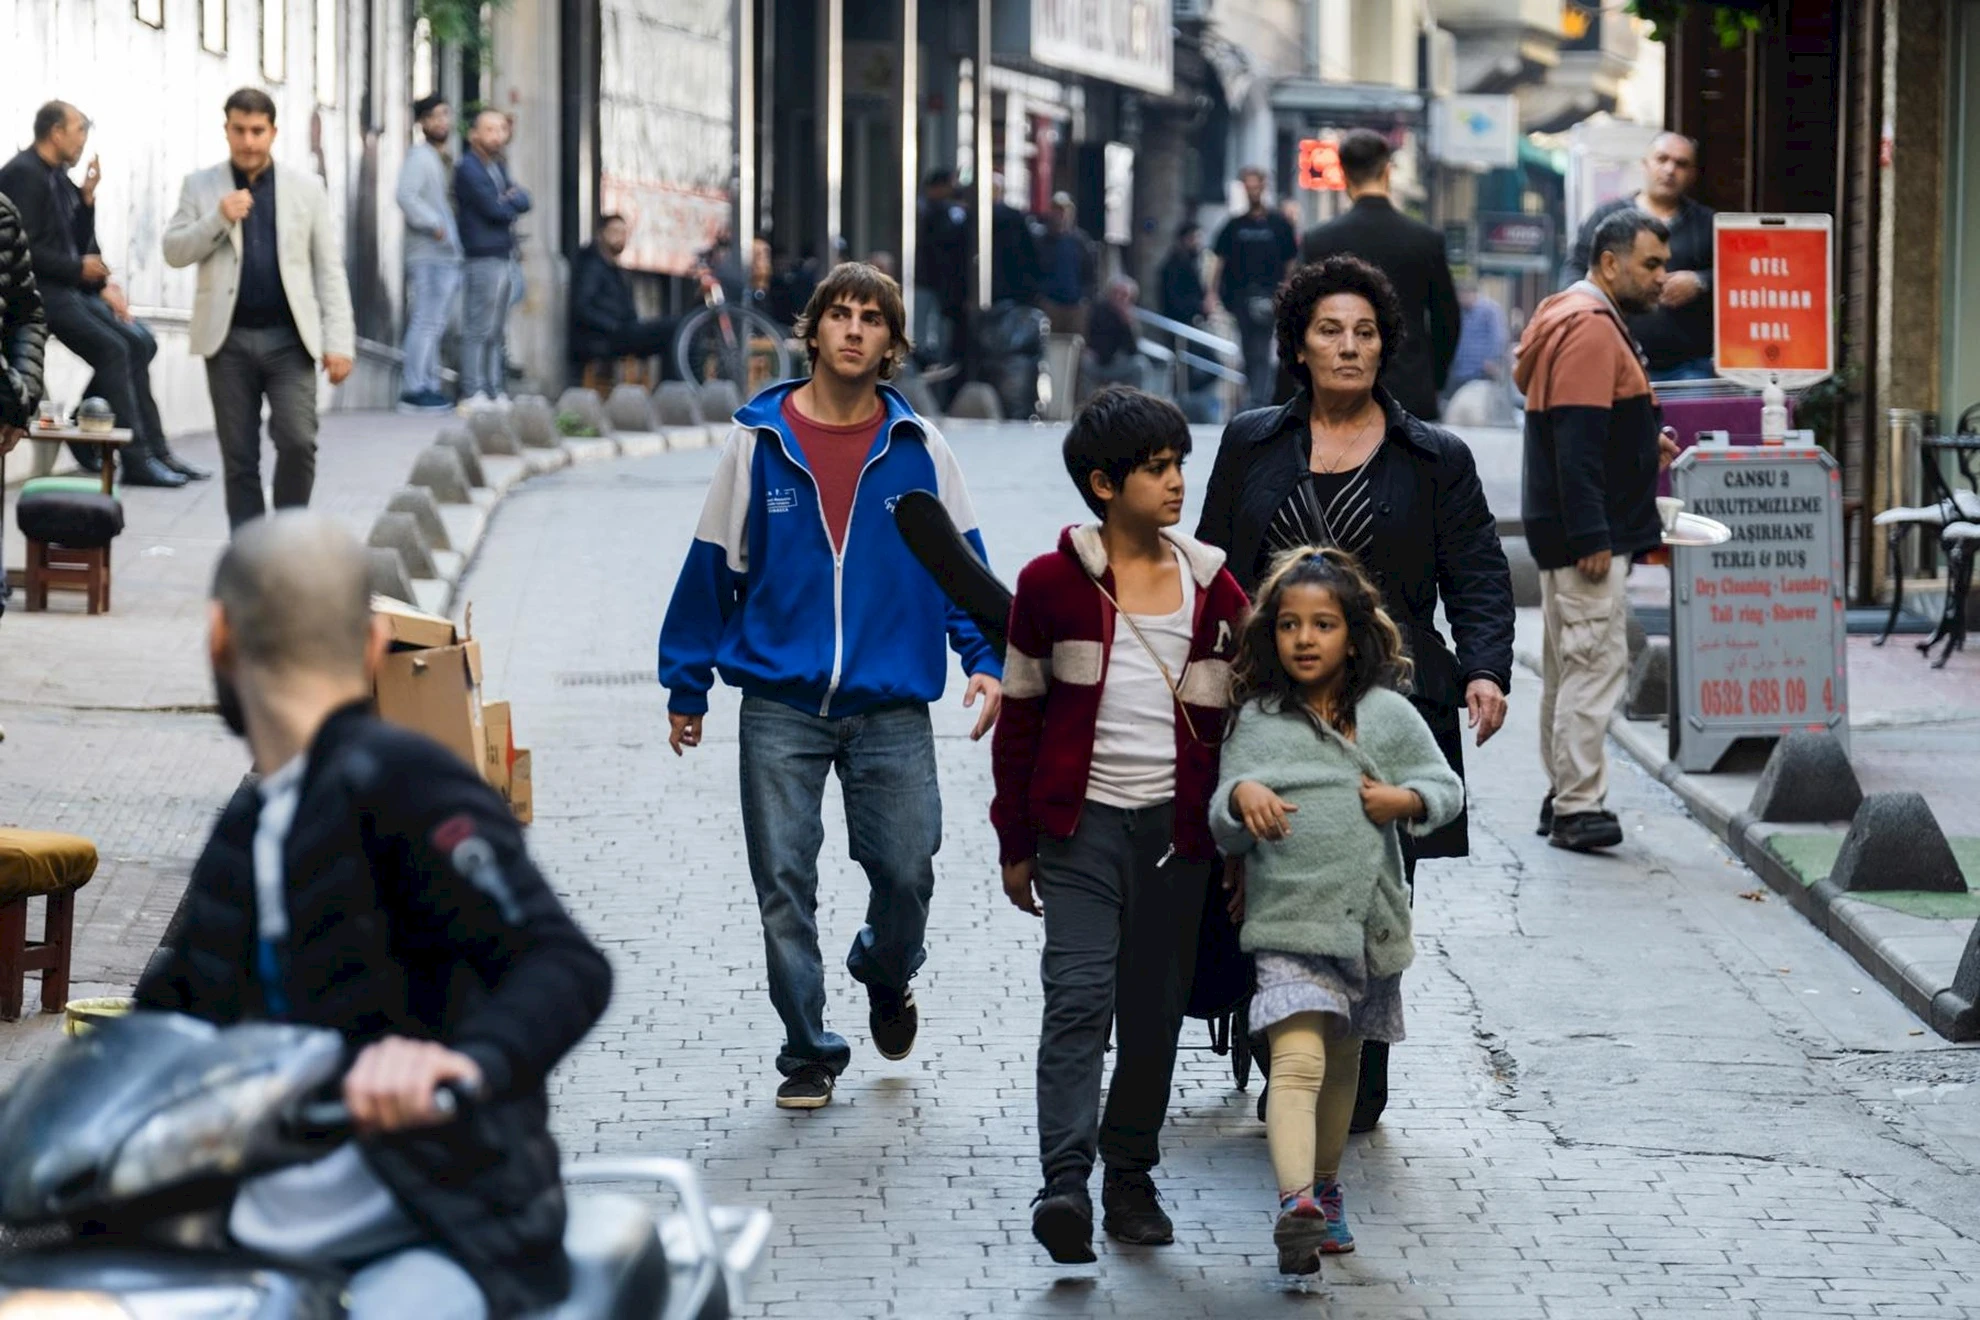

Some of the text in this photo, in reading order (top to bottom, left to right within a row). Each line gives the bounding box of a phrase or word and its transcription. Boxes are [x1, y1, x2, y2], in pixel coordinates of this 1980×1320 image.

[1750, 256, 1790, 276] OTEL
[1723, 469, 1777, 488] CANSU
[1775, 549, 1807, 569] DUŞ
[1696, 574, 1829, 598] Dry Cleaning Laundry
[1771, 603, 1817, 623] Shower
[1701, 678, 1744, 715] 0532
[1748, 677, 1781, 715] 638
